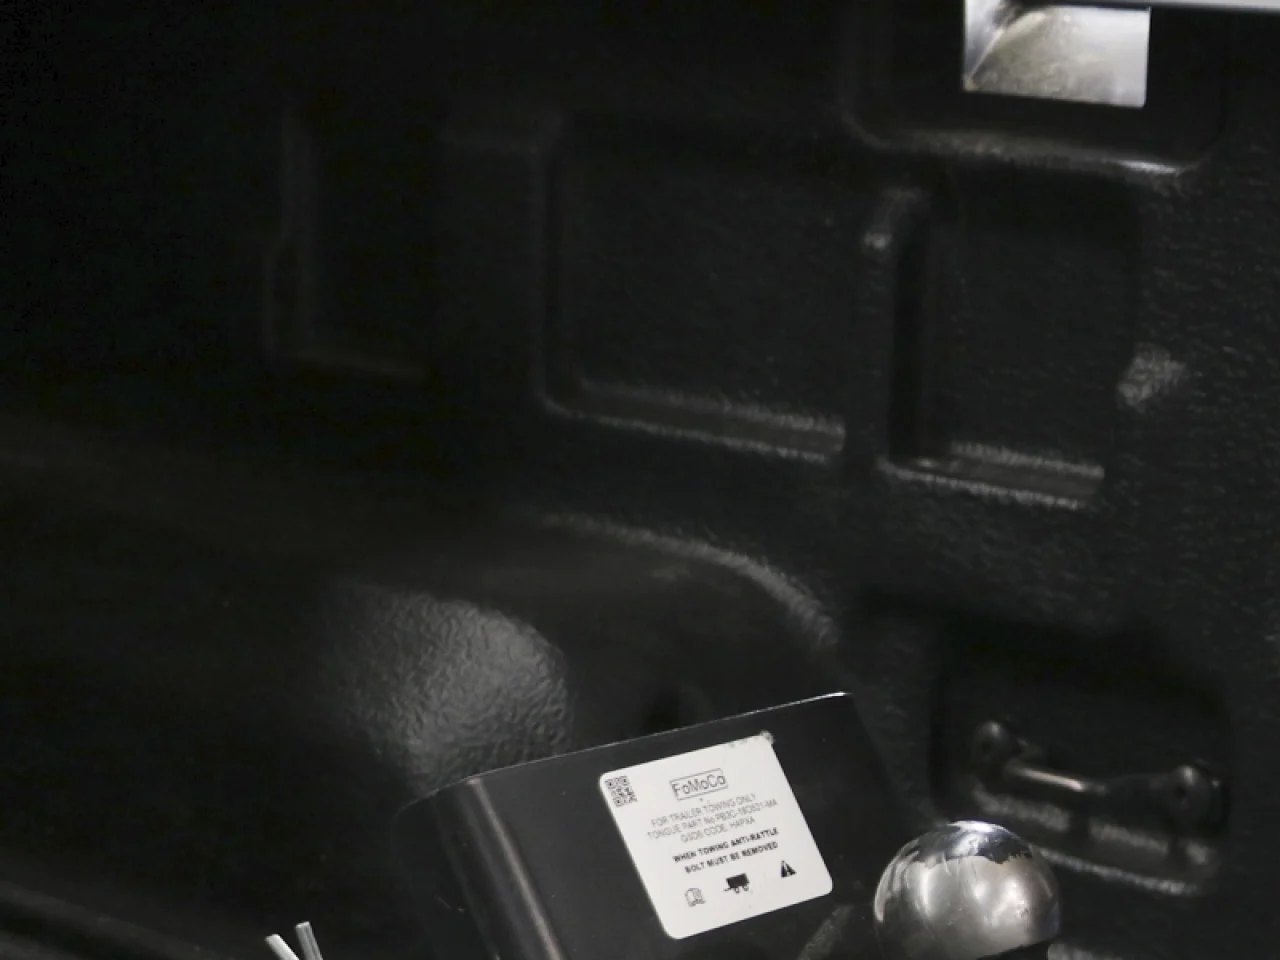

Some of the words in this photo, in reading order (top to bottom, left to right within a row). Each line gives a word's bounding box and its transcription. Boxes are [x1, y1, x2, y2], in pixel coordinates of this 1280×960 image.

[671, 773, 727, 797] FoMoCo
[651, 816, 668, 828] FOR
[669, 807, 702, 820] TRAILER
[702, 798, 736, 813] TOWING
[736, 792, 756, 805] ONLY
[647, 824, 681, 839] TONGUE
[681, 818, 701, 830] PART
[673, 850, 697, 863] WHEN
[697, 841, 729, 856] TOWING
[730, 827, 779, 847] ANTI-RATTLE
[684, 861, 705, 874] BOLT
[706, 855, 728, 868] MUST
[729, 851, 740, 861] BE
[741, 841, 779, 858] REMOVED
